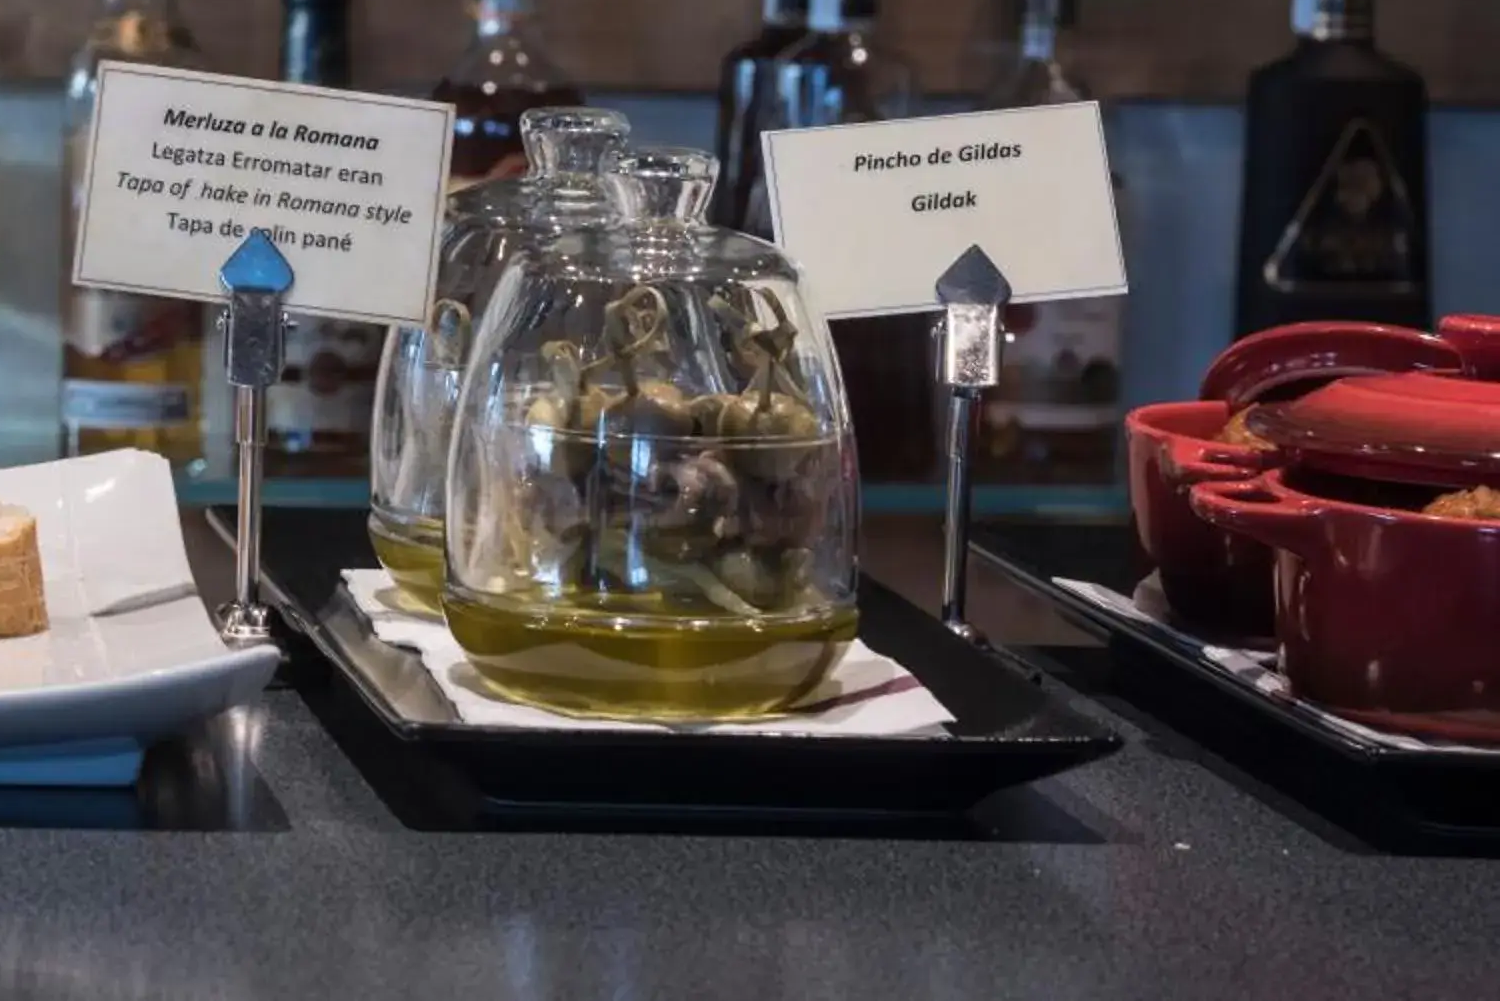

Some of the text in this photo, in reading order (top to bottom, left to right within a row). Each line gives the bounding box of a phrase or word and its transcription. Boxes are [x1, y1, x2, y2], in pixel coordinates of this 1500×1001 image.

[163, 108, 380, 150] Merluza a la Romana
[151, 141, 383, 186] Legatza Erromatar eran
[853, 141, 1023, 172] Pincho de Gildas
[116, 170, 413, 225] Tapa of hake in Romana style
[911, 190, 978, 213] Gildak
[166, 211, 214, 237] Tapa
[219, 218, 244, 238] de
[302, 231, 353, 253] pané
